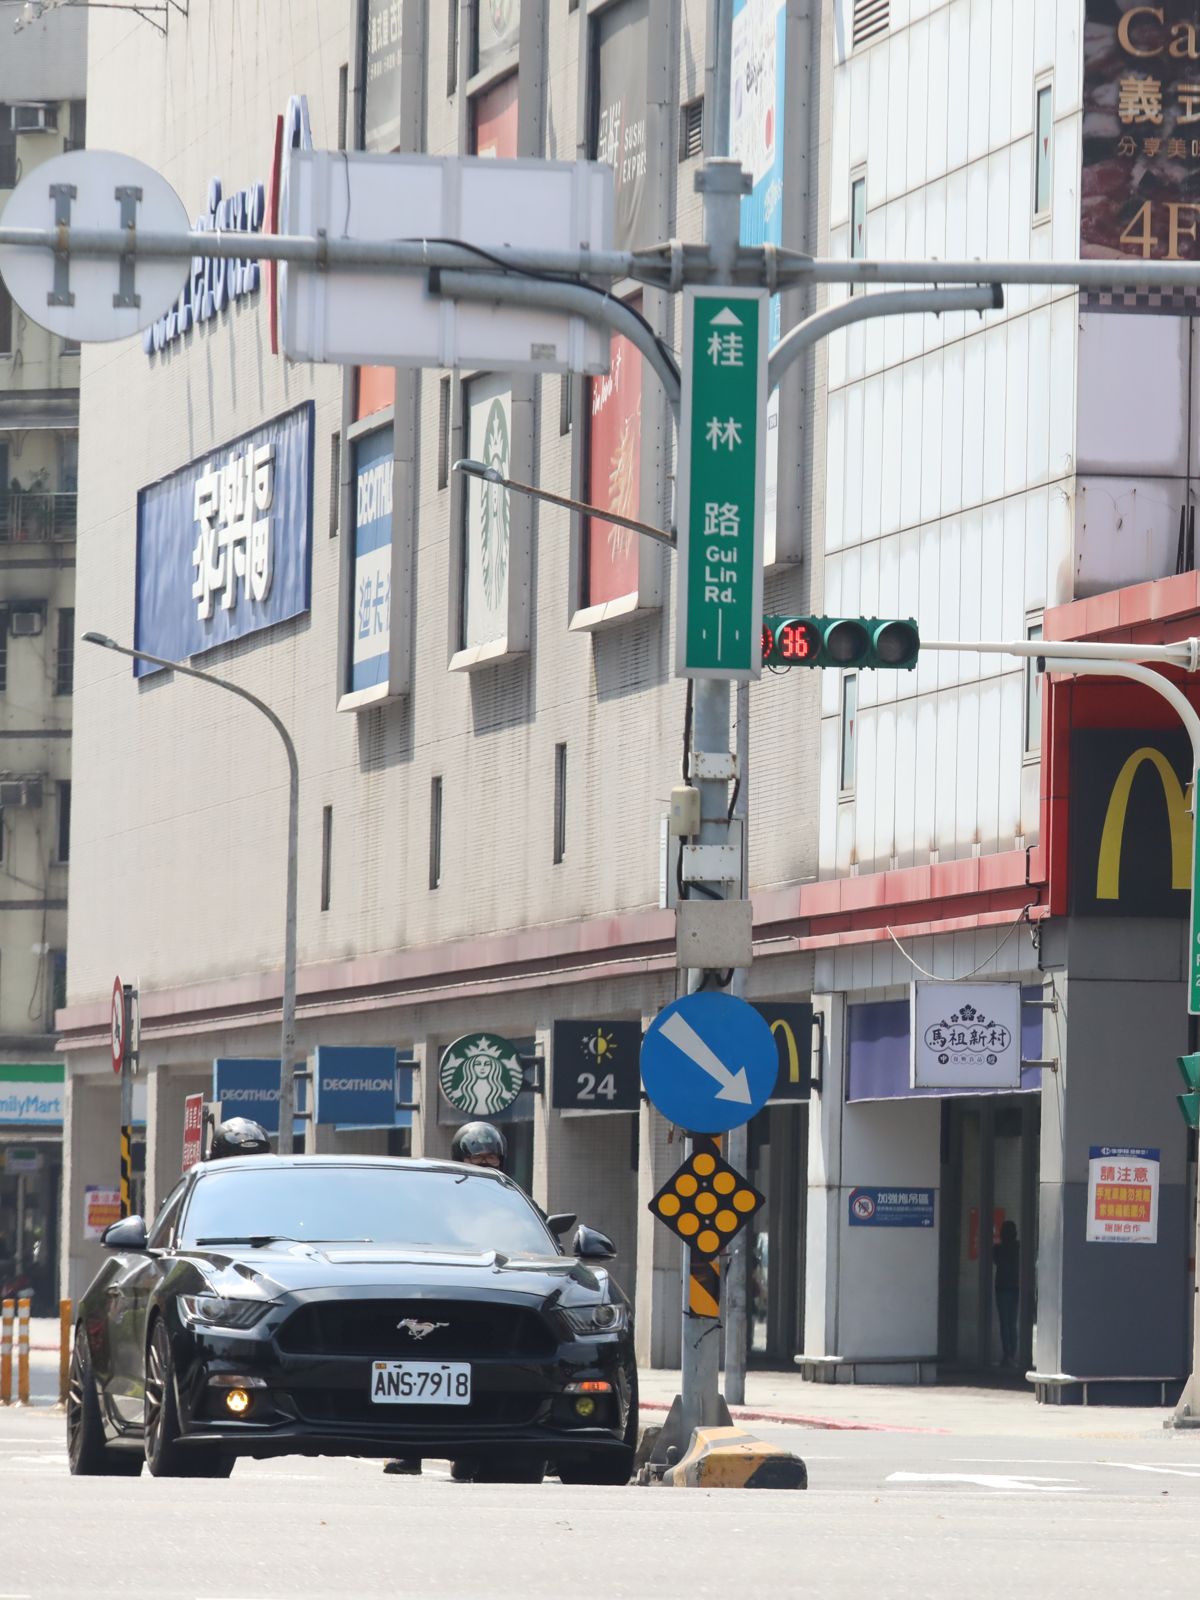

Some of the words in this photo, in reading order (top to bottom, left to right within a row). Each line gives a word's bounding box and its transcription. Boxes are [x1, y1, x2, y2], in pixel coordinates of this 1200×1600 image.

[703, 331, 744, 538] 桂林路
[706, 545, 738, 564] Gui
[704, 565, 737, 584] Lin
[358, 567, 392, 640] 迪卡
[704, 585, 737, 604] Rd.
[783, 626, 808, 657] 36
[929, 1028, 1007, 1048] 馬祖新村
[323, 1077, 394, 1092] DECATHLON
[577, 1073, 617, 1100] 24
[1100, 1166, 1149, 1183] 請注意
